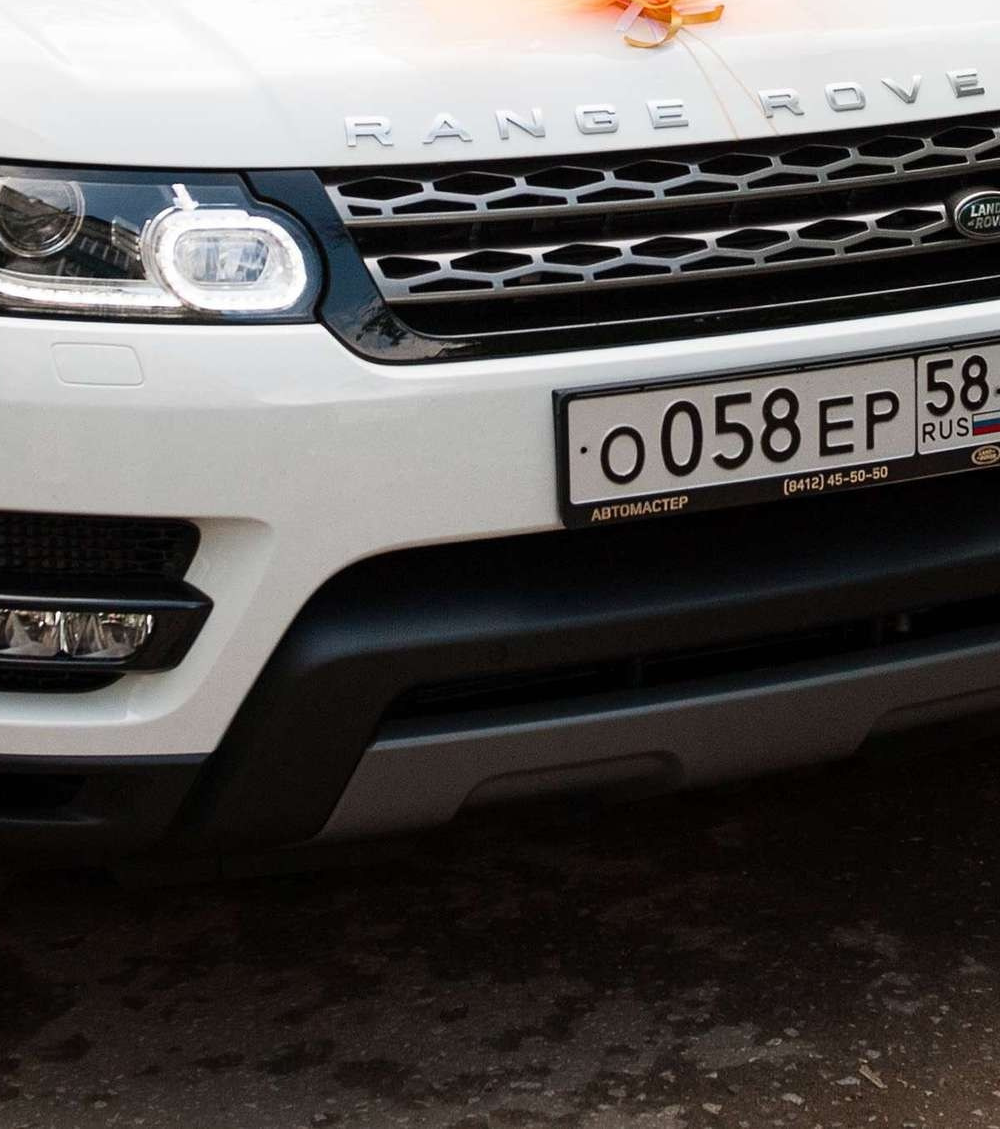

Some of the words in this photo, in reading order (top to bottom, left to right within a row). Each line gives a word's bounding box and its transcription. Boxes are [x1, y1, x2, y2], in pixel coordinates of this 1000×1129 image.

[344, 99, 689, 148] RANGE
[758, 67, 985, 119] ROVE
[926, 355, 989, 416] 58
[922, 417, 970, 443] RUS
[783, 473, 824, 495] (8412)
[827, 465, 889, 486] 45-50-50
[591, 495, 689, 521] АВТОМАСТЕР
